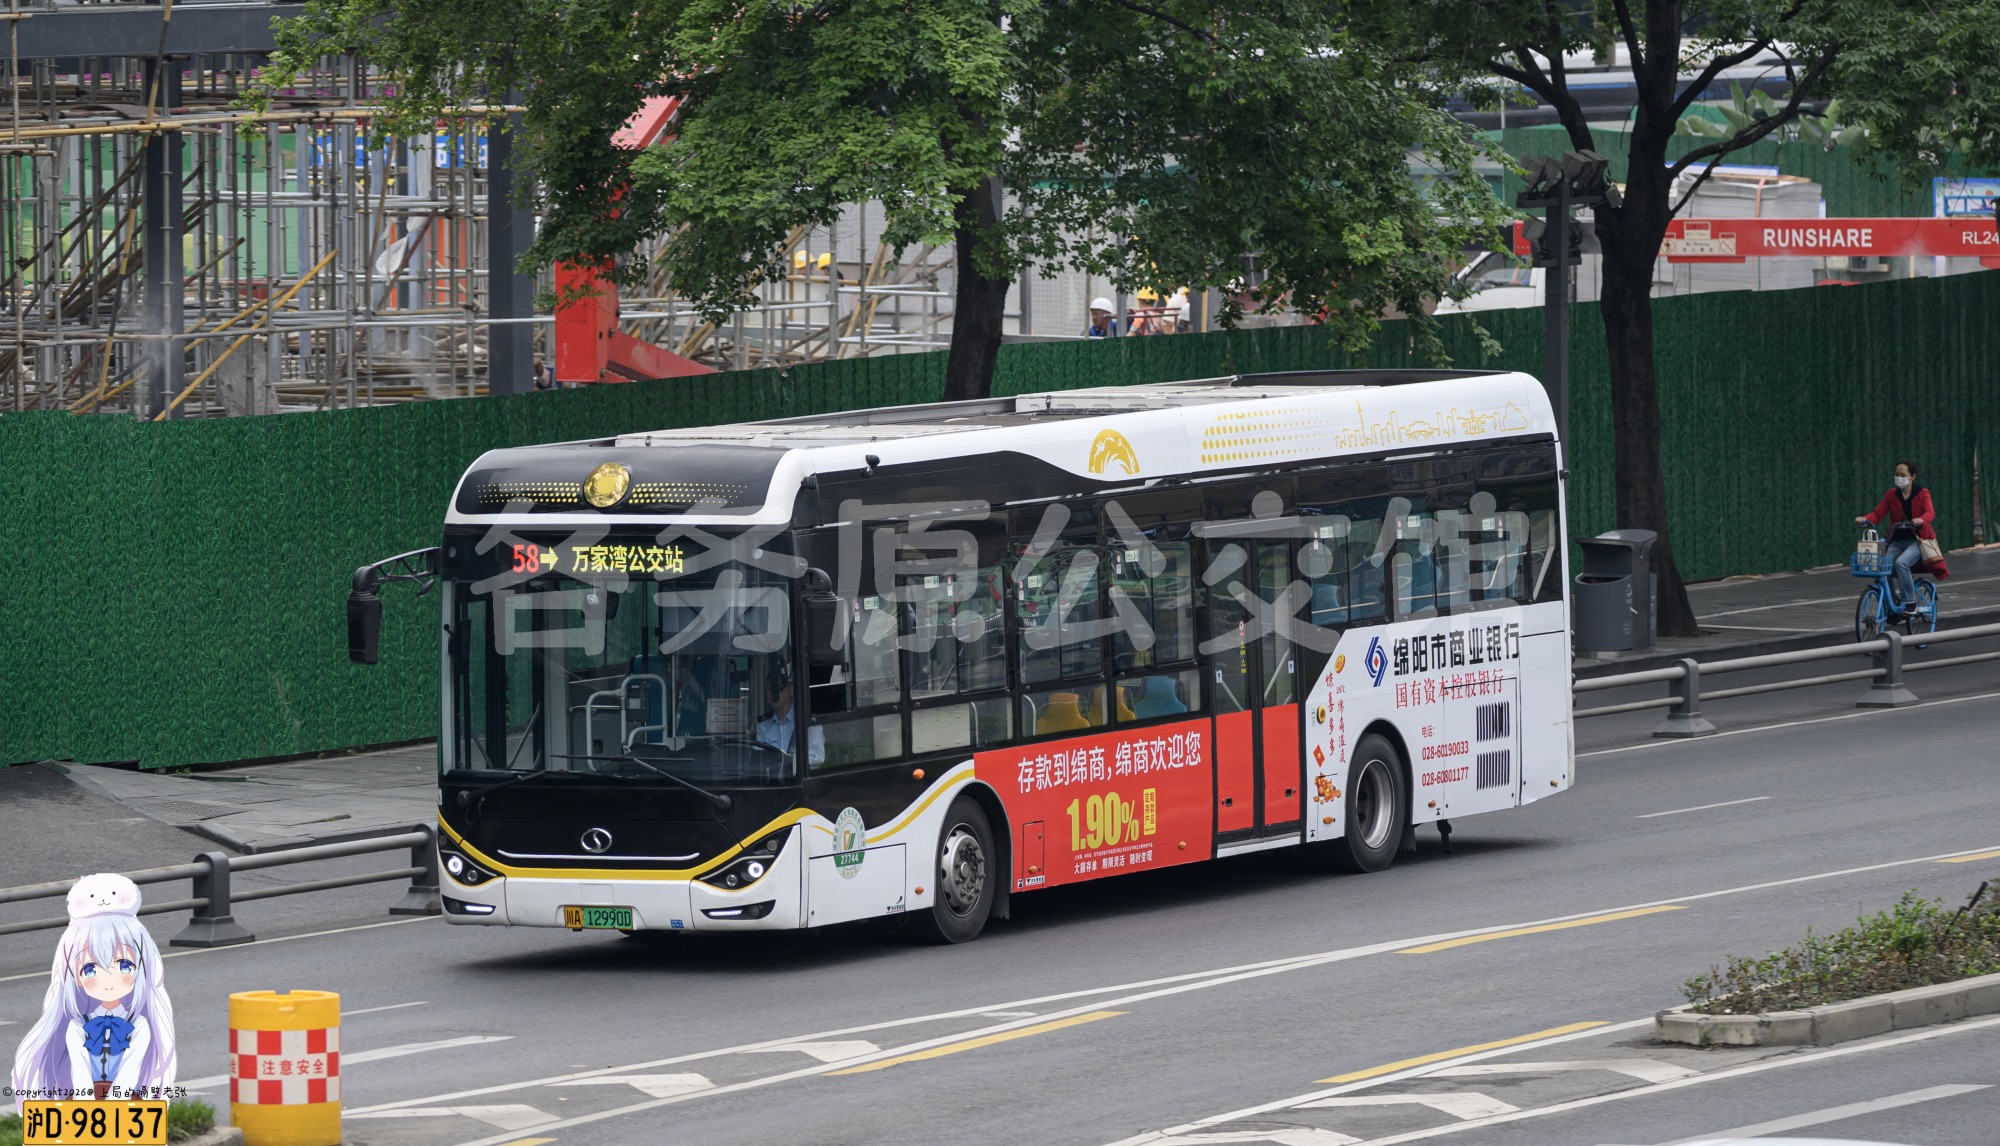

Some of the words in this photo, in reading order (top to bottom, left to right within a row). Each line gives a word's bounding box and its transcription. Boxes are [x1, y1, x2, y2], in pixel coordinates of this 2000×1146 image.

[1763, 228, 1873, 248] RUNSHARE
[512, 544, 540, 573] 58
[571, 545, 683, 573] 万家湾公交站
[1393, 623, 1520, 676] 绵阳市商业银行
[1395, 668, 1504, 710] 国有资本控股银行
[1421, 740, 1469, 760] 028-60190033
[1421, 766, 1469, 787] 028-60801177
[1066, 791, 1140, 851] 1.90%
[840, 853, 859, 865] 27744
[1074, 860, 1098, 875] 大额存单
[262, 1059, 324, 1075] 注意安全
